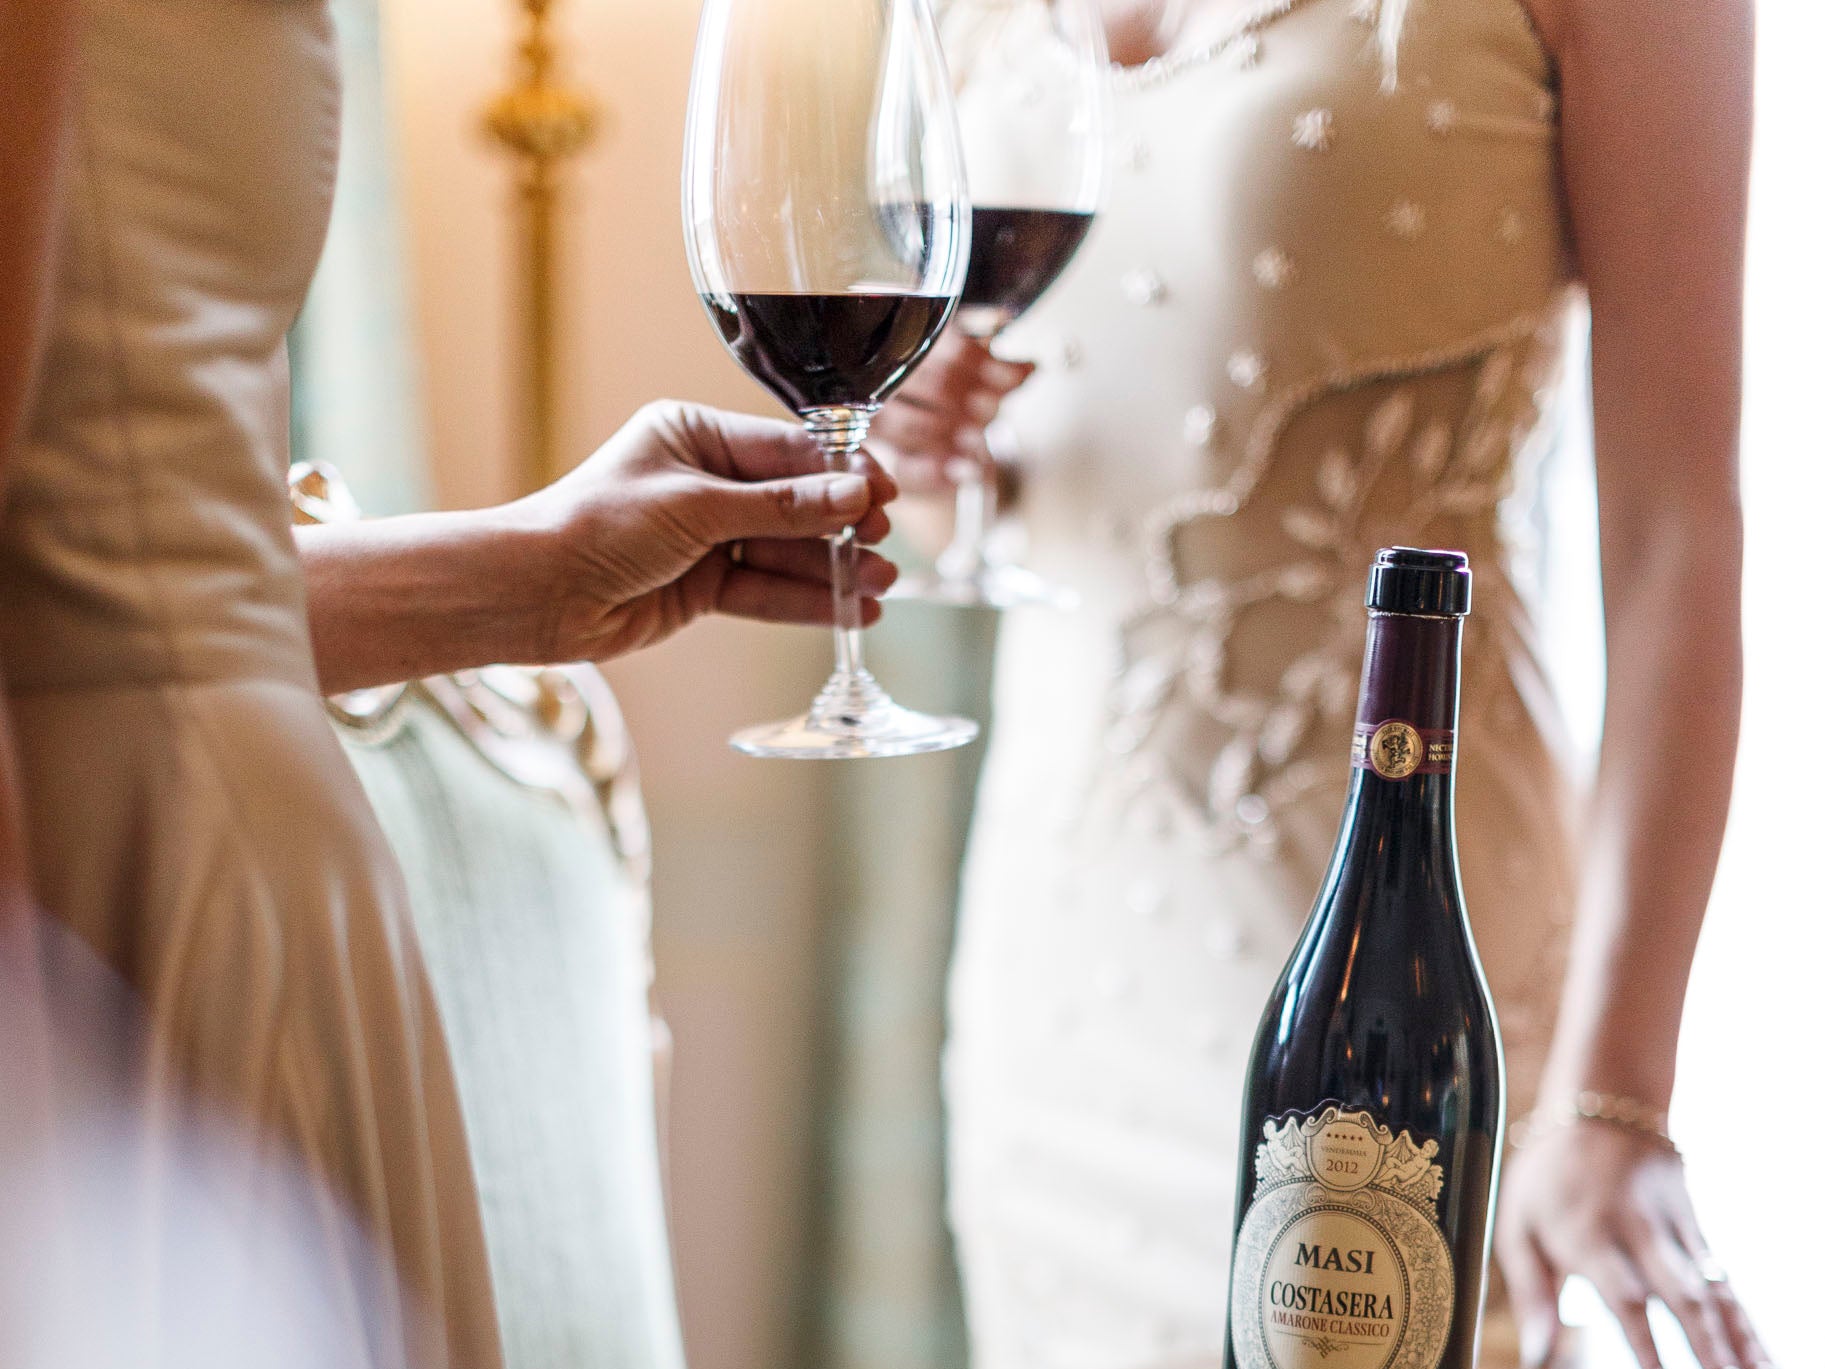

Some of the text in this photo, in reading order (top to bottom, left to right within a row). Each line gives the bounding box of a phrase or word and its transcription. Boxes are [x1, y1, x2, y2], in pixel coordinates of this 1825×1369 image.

[1326, 1159, 1358, 1174] 2012
[1294, 1242, 1375, 1274] MASI
[1271, 1280, 1394, 1320] COSTASERA
[1271, 1310, 1390, 1337] AMARONE CLASSICO
